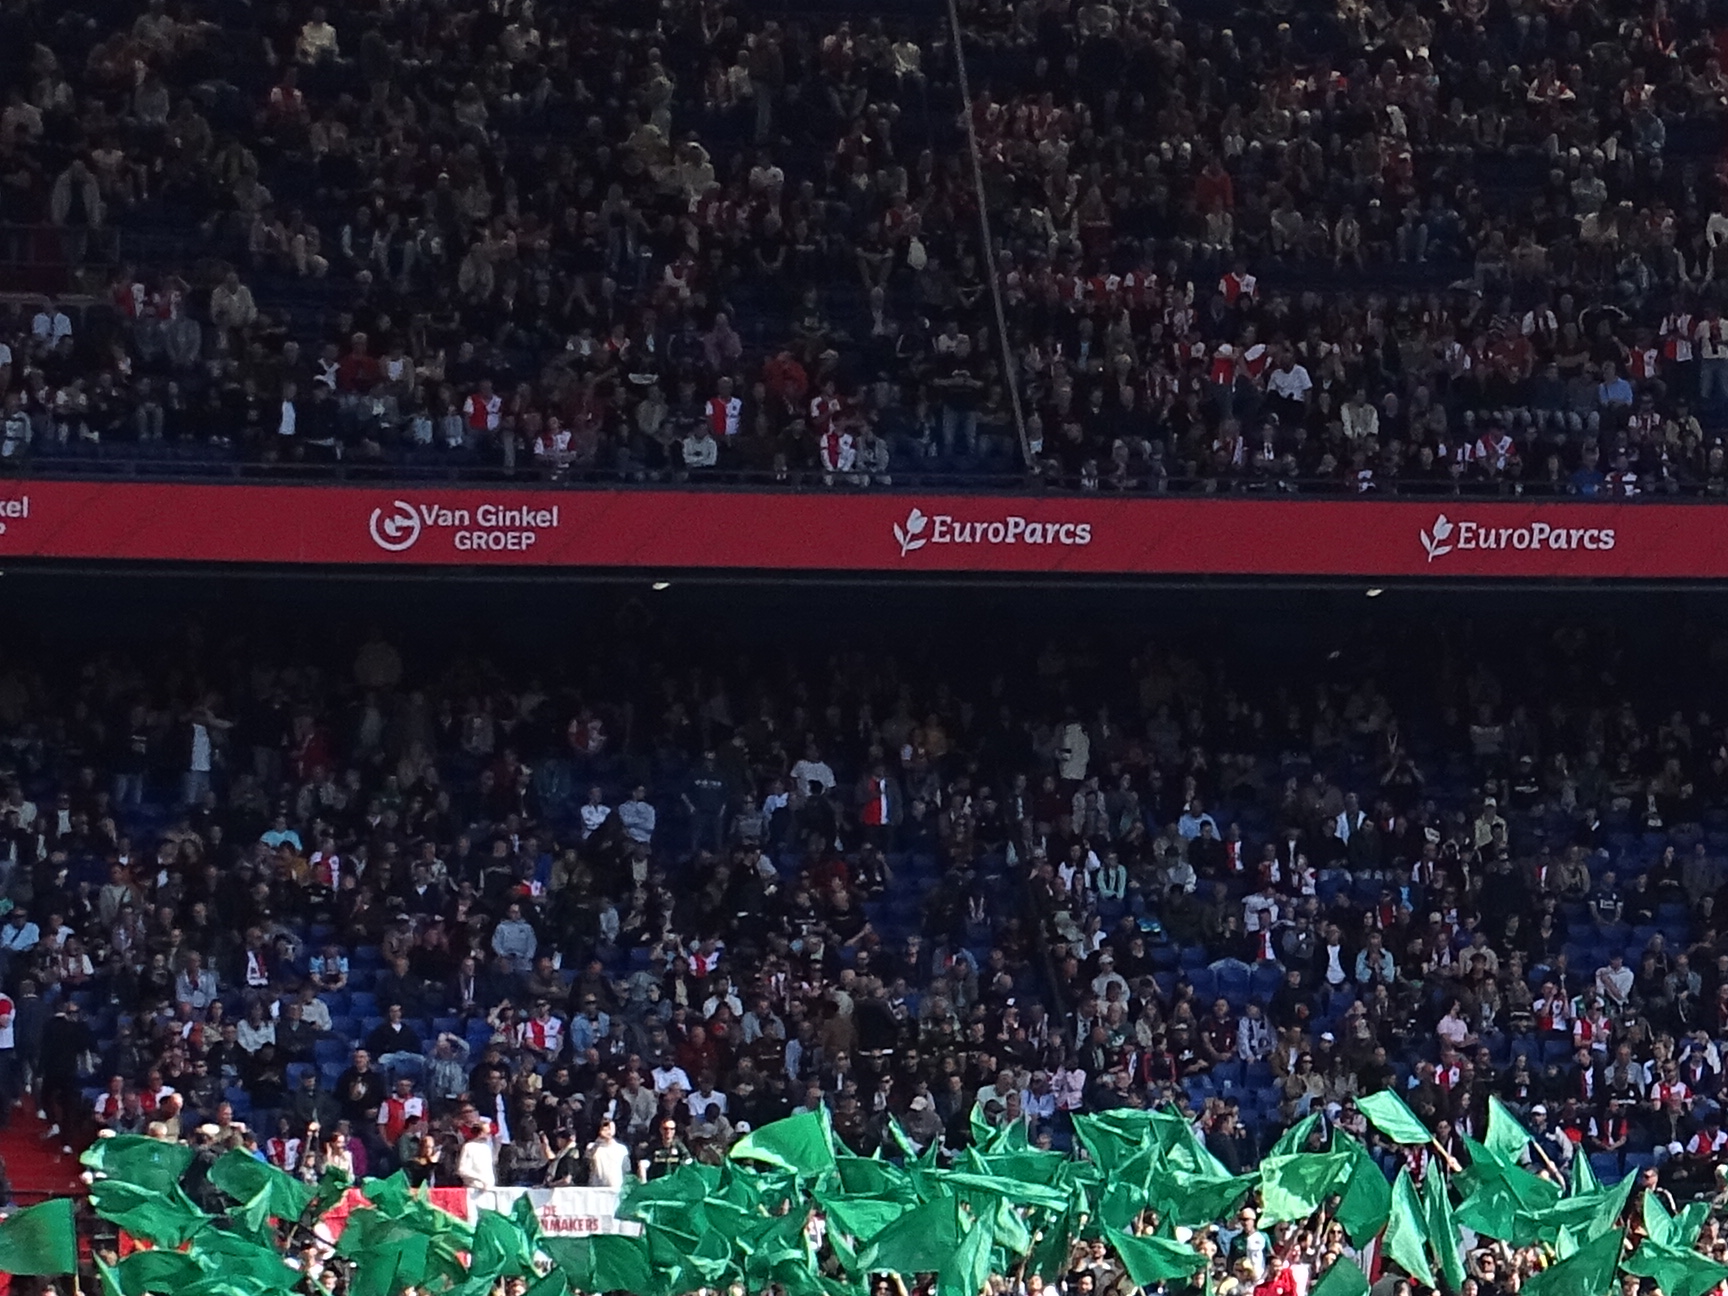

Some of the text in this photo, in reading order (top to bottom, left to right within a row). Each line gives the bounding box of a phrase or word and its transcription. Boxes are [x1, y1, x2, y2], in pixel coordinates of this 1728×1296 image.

[420, 504, 559, 528] Van Ginkel
[455, 531, 536, 551] GROEP
[932, 515, 1092, 546] EuroParcs
[1457, 522, 1616, 551] EuroParcs
